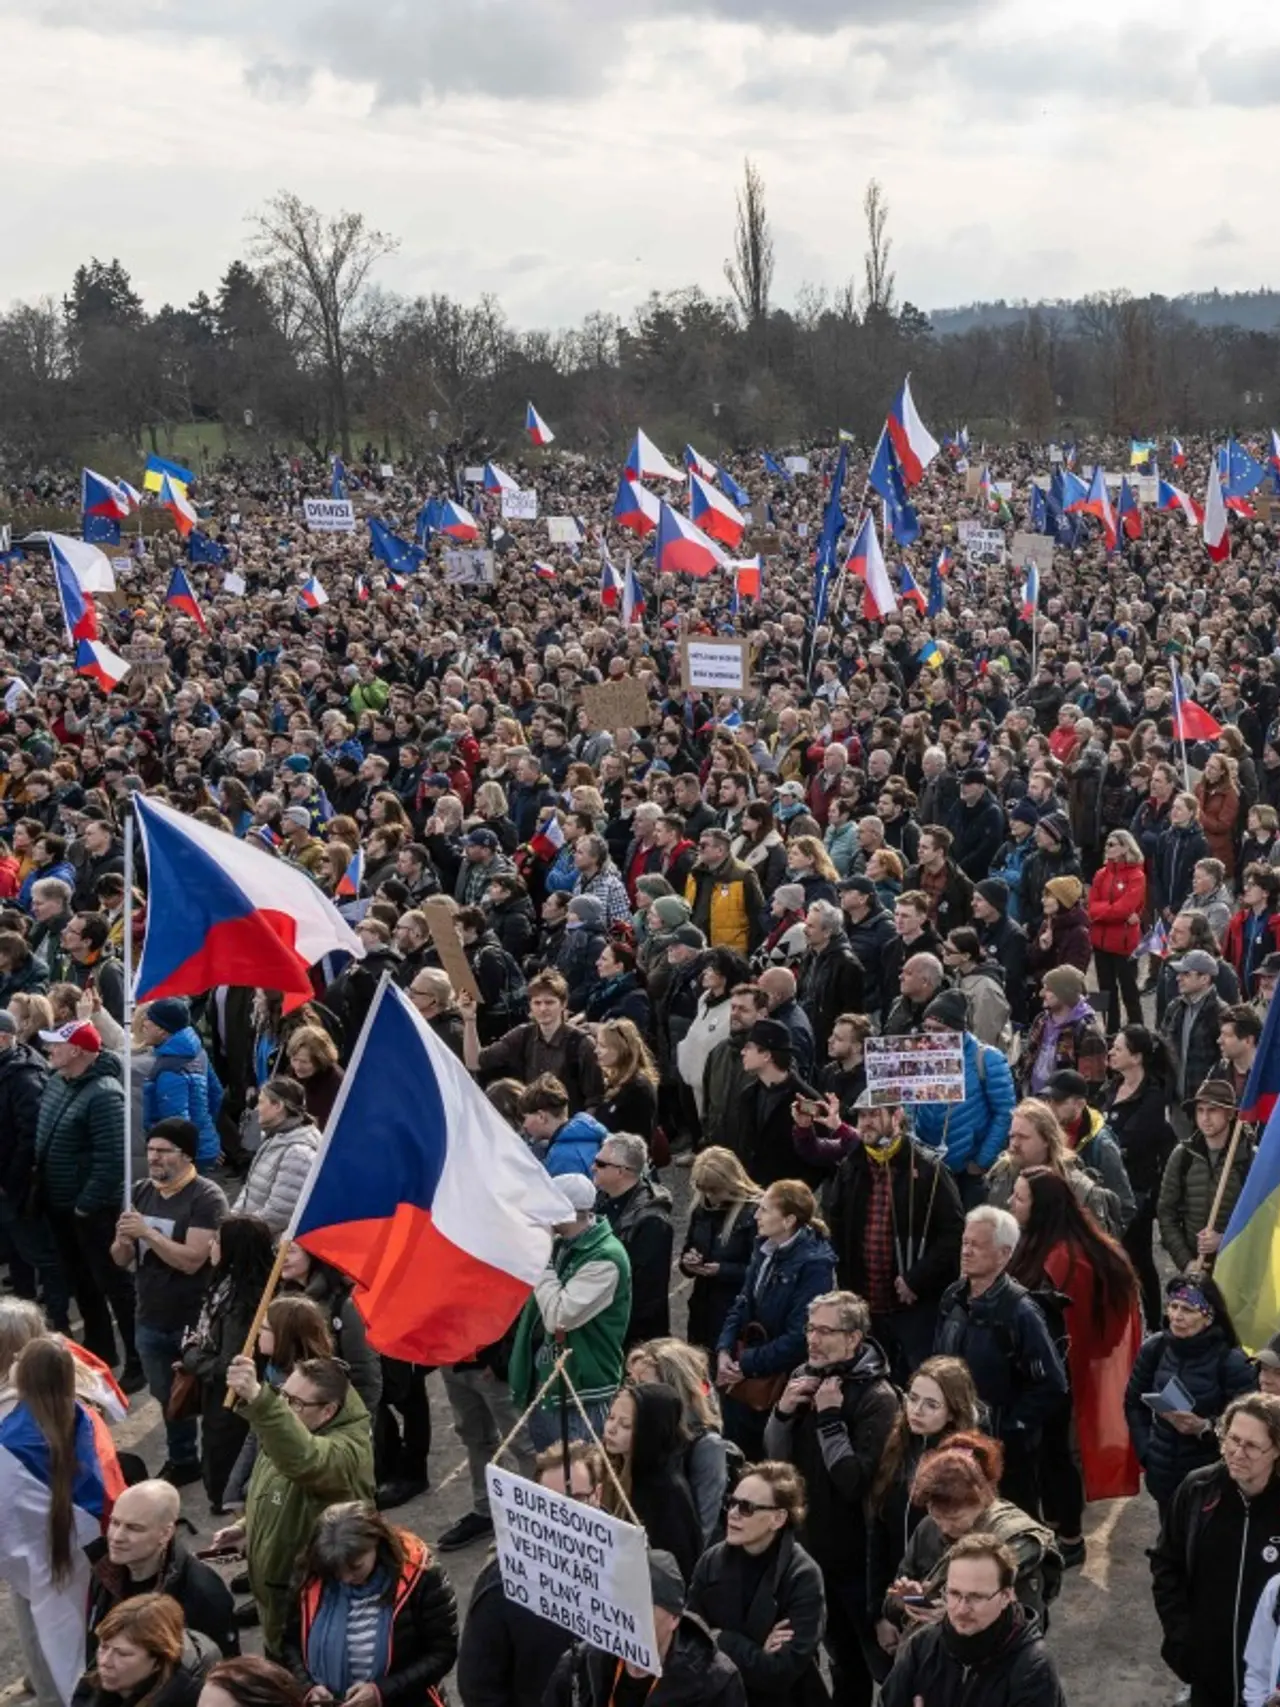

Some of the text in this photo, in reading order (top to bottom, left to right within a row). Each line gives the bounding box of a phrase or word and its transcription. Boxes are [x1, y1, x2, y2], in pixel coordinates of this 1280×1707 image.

[492, 1478, 614, 1549] S BUREŠOVCI
[506, 1510, 605, 1567] PITOMIOVCI
[503, 1555, 636, 1635] NA PLNÝ PLYN
[511, 1533, 600, 1591] VEJFUKÁŘI
[503, 1579, 651, 1668] DO BABIŠISTÁNU
